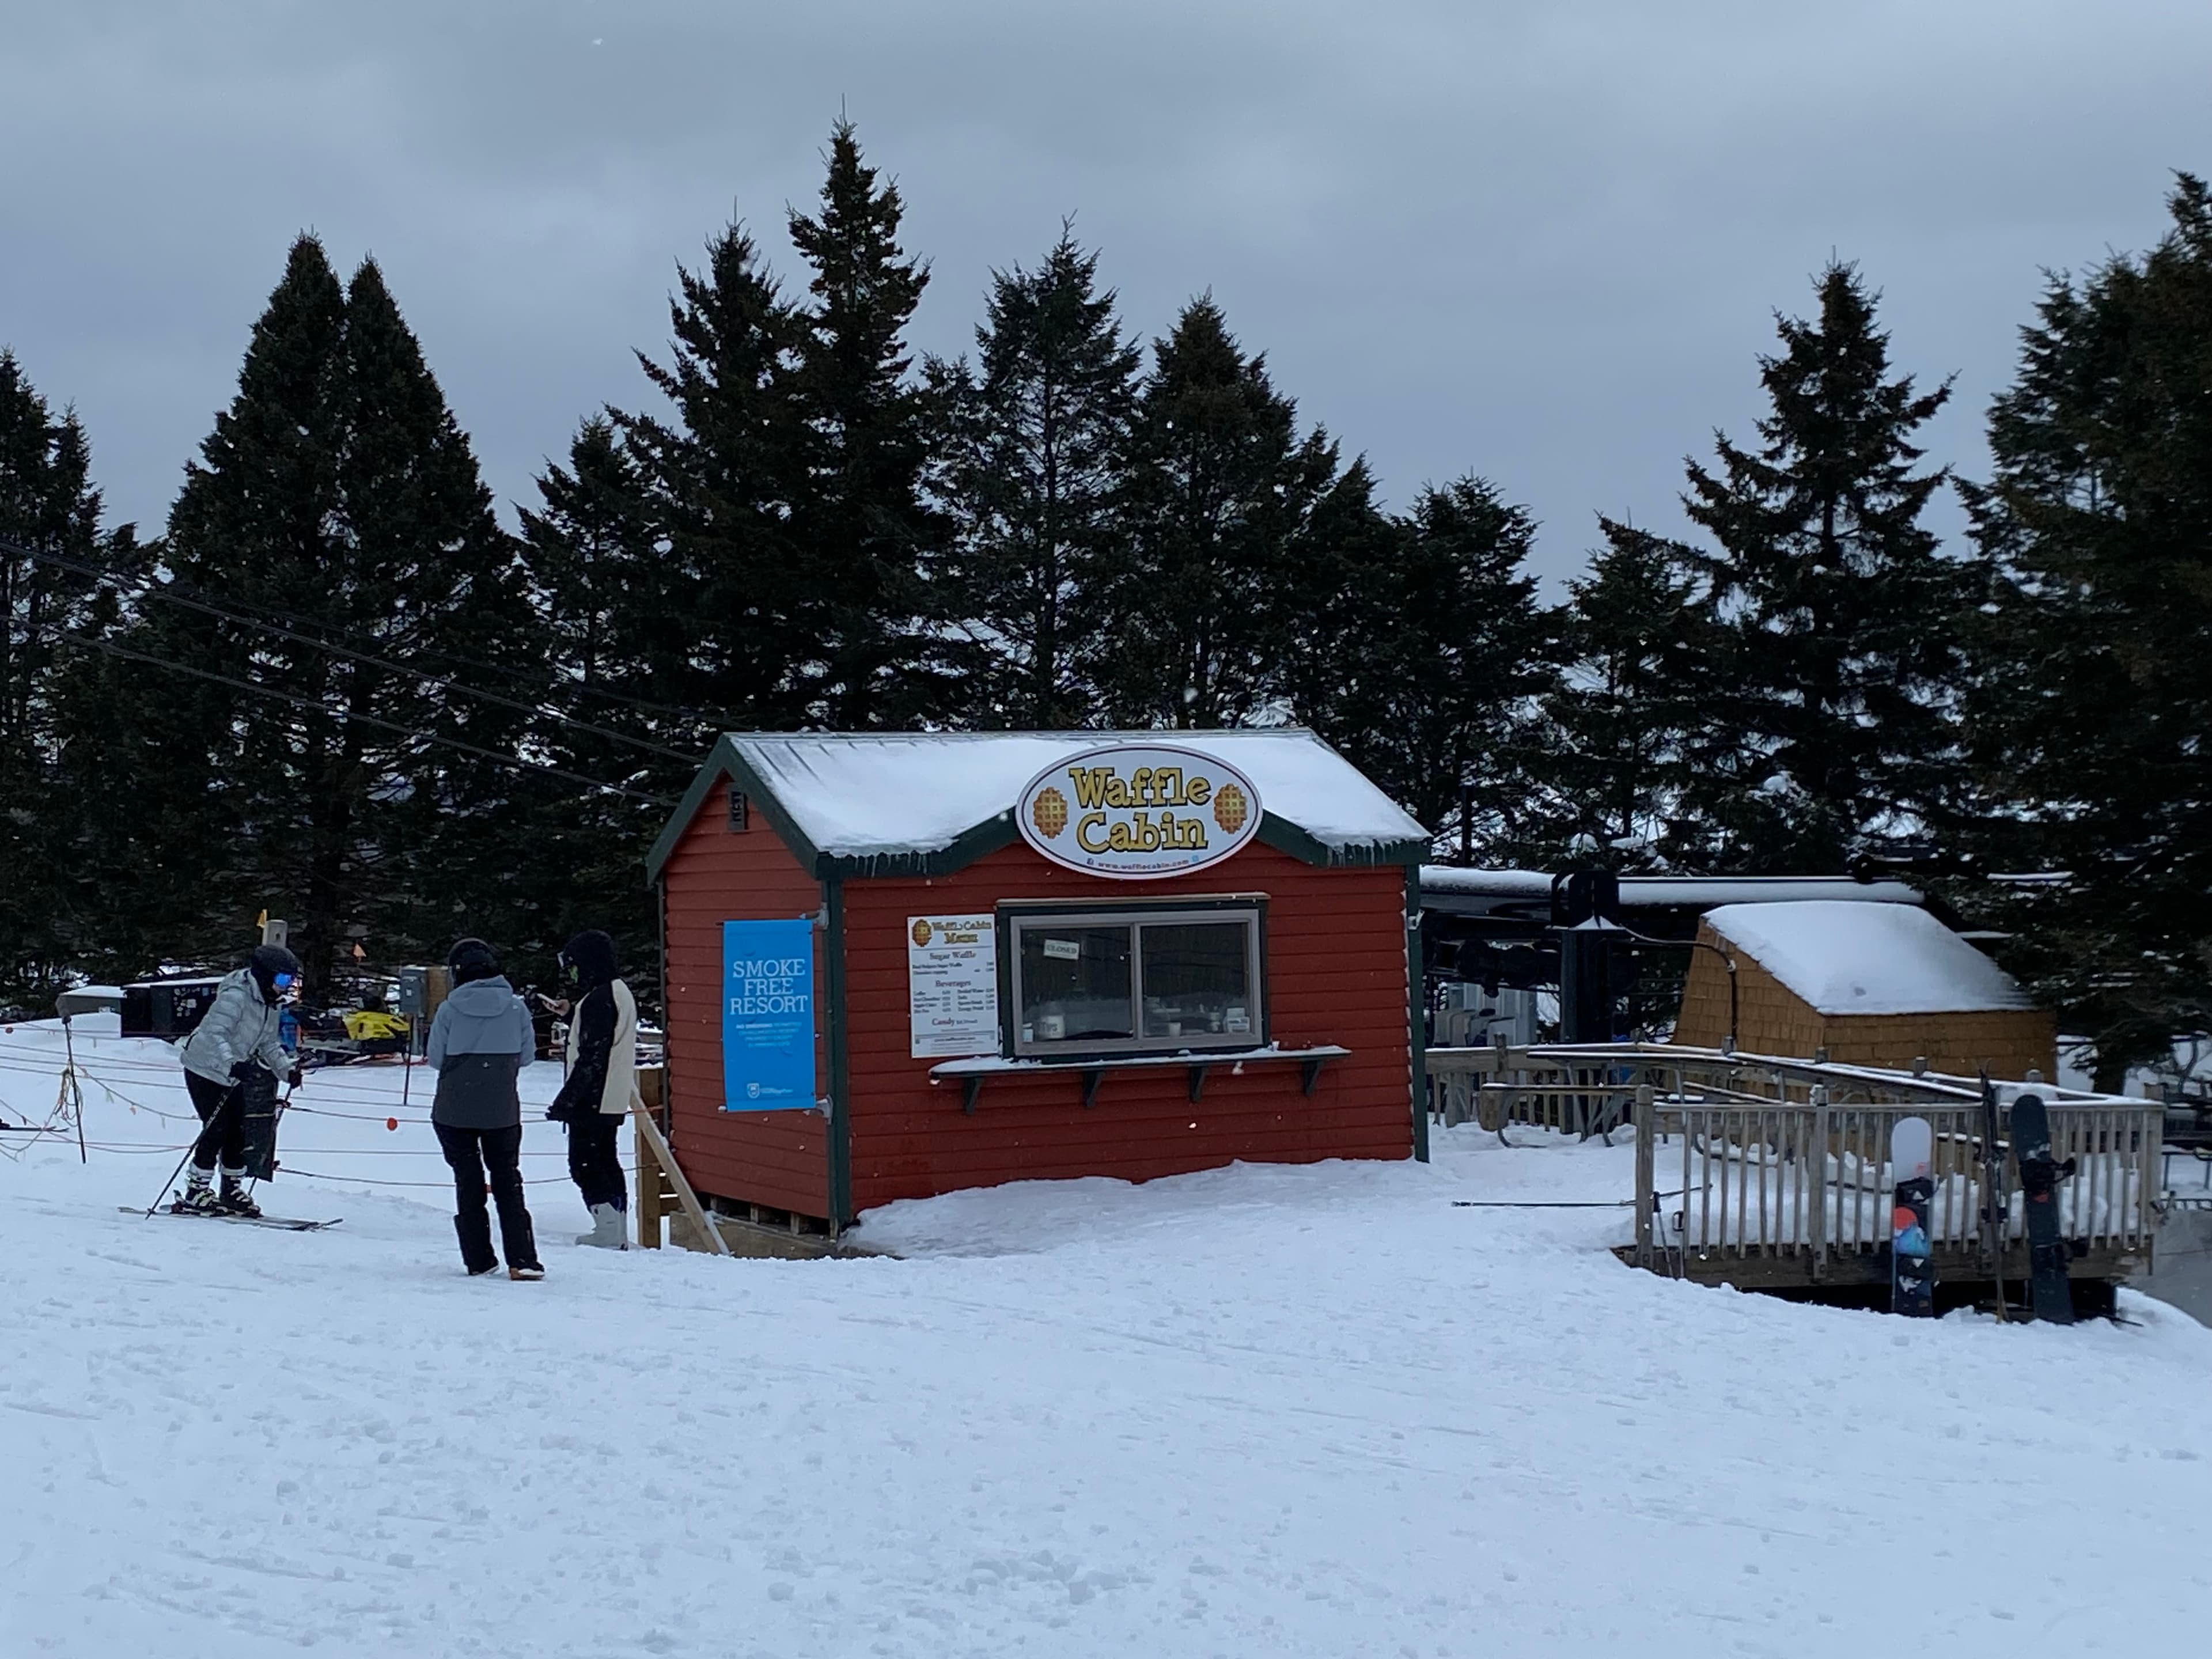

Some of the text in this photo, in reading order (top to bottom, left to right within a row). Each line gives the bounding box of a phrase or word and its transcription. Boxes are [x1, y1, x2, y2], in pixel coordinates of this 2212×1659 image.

[1069, 767, 1211, 809] Waffle
[1077, 812, 1207, 854] Cabin
[1047, 945, 1077, 954] CLOSED
[733, 959, 805, 978] SMOKE
[744, 978, 793, 996] FREE
[730, 996, 808, 1014] RESORT
[931, 1017, 955, 1026] Candy
